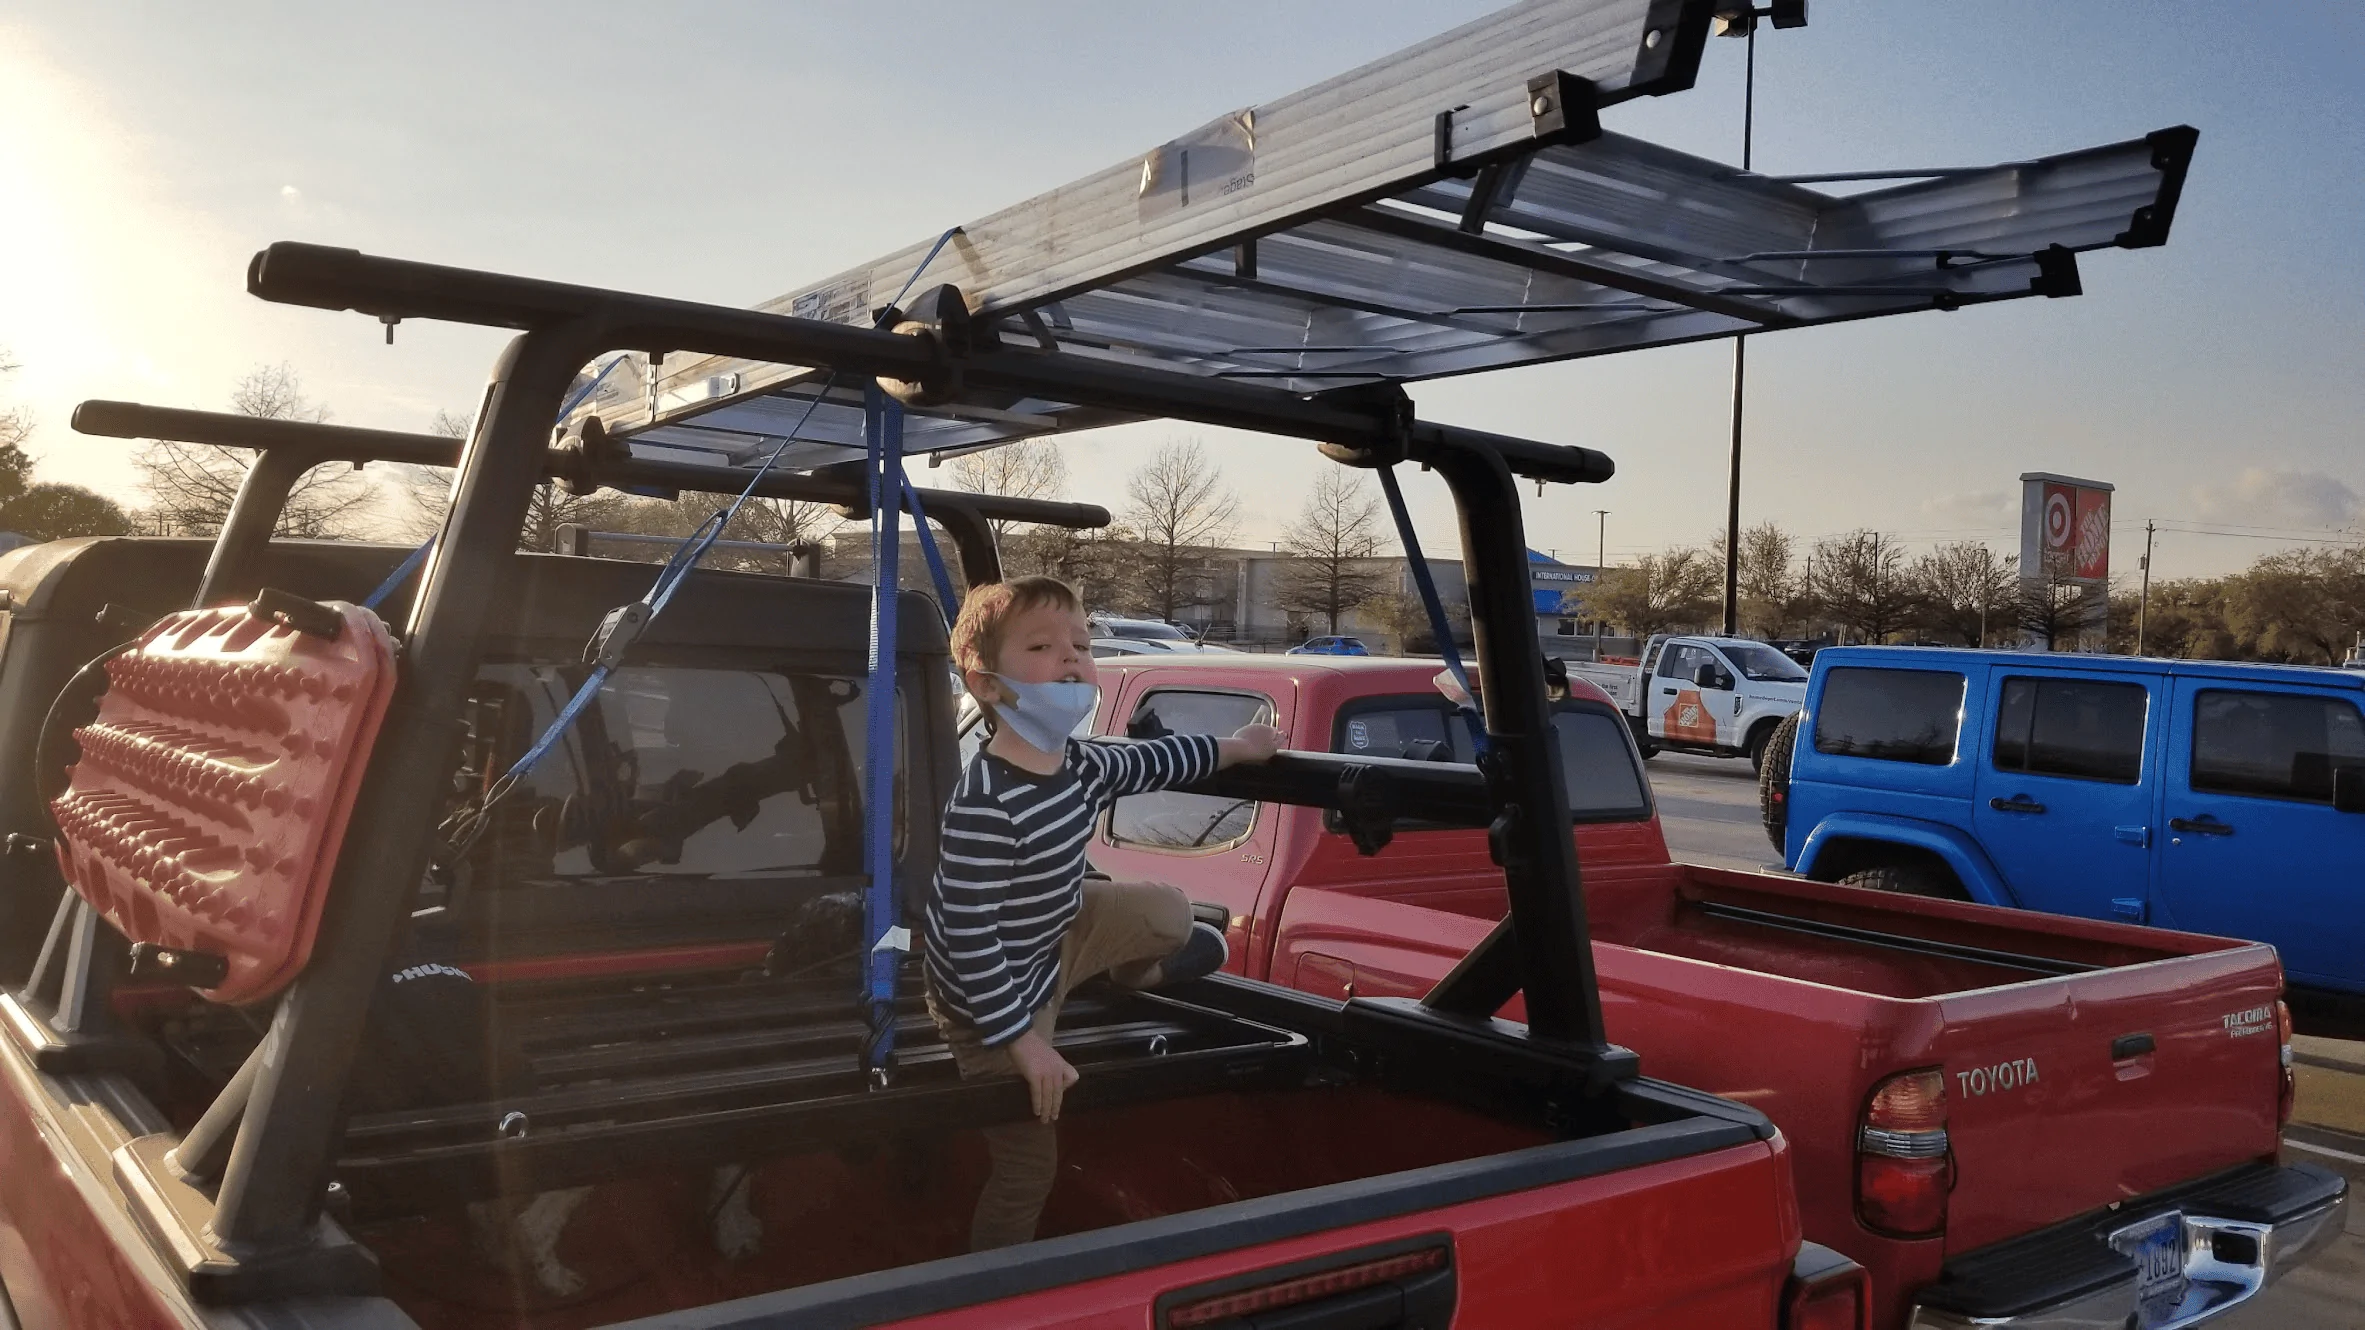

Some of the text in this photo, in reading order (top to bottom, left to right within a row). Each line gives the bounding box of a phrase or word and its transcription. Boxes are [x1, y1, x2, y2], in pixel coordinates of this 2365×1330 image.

[1535, 571, 1573, 581] INTERNATIONAL
[1573, 573, 1591, 582] HOUSE
[2222, 1006, 2272, 1029] TACOMA
[1956, 1057, 2040, 1099] TOYOTA
[2147, 1239, 2177, 1281] 1892
